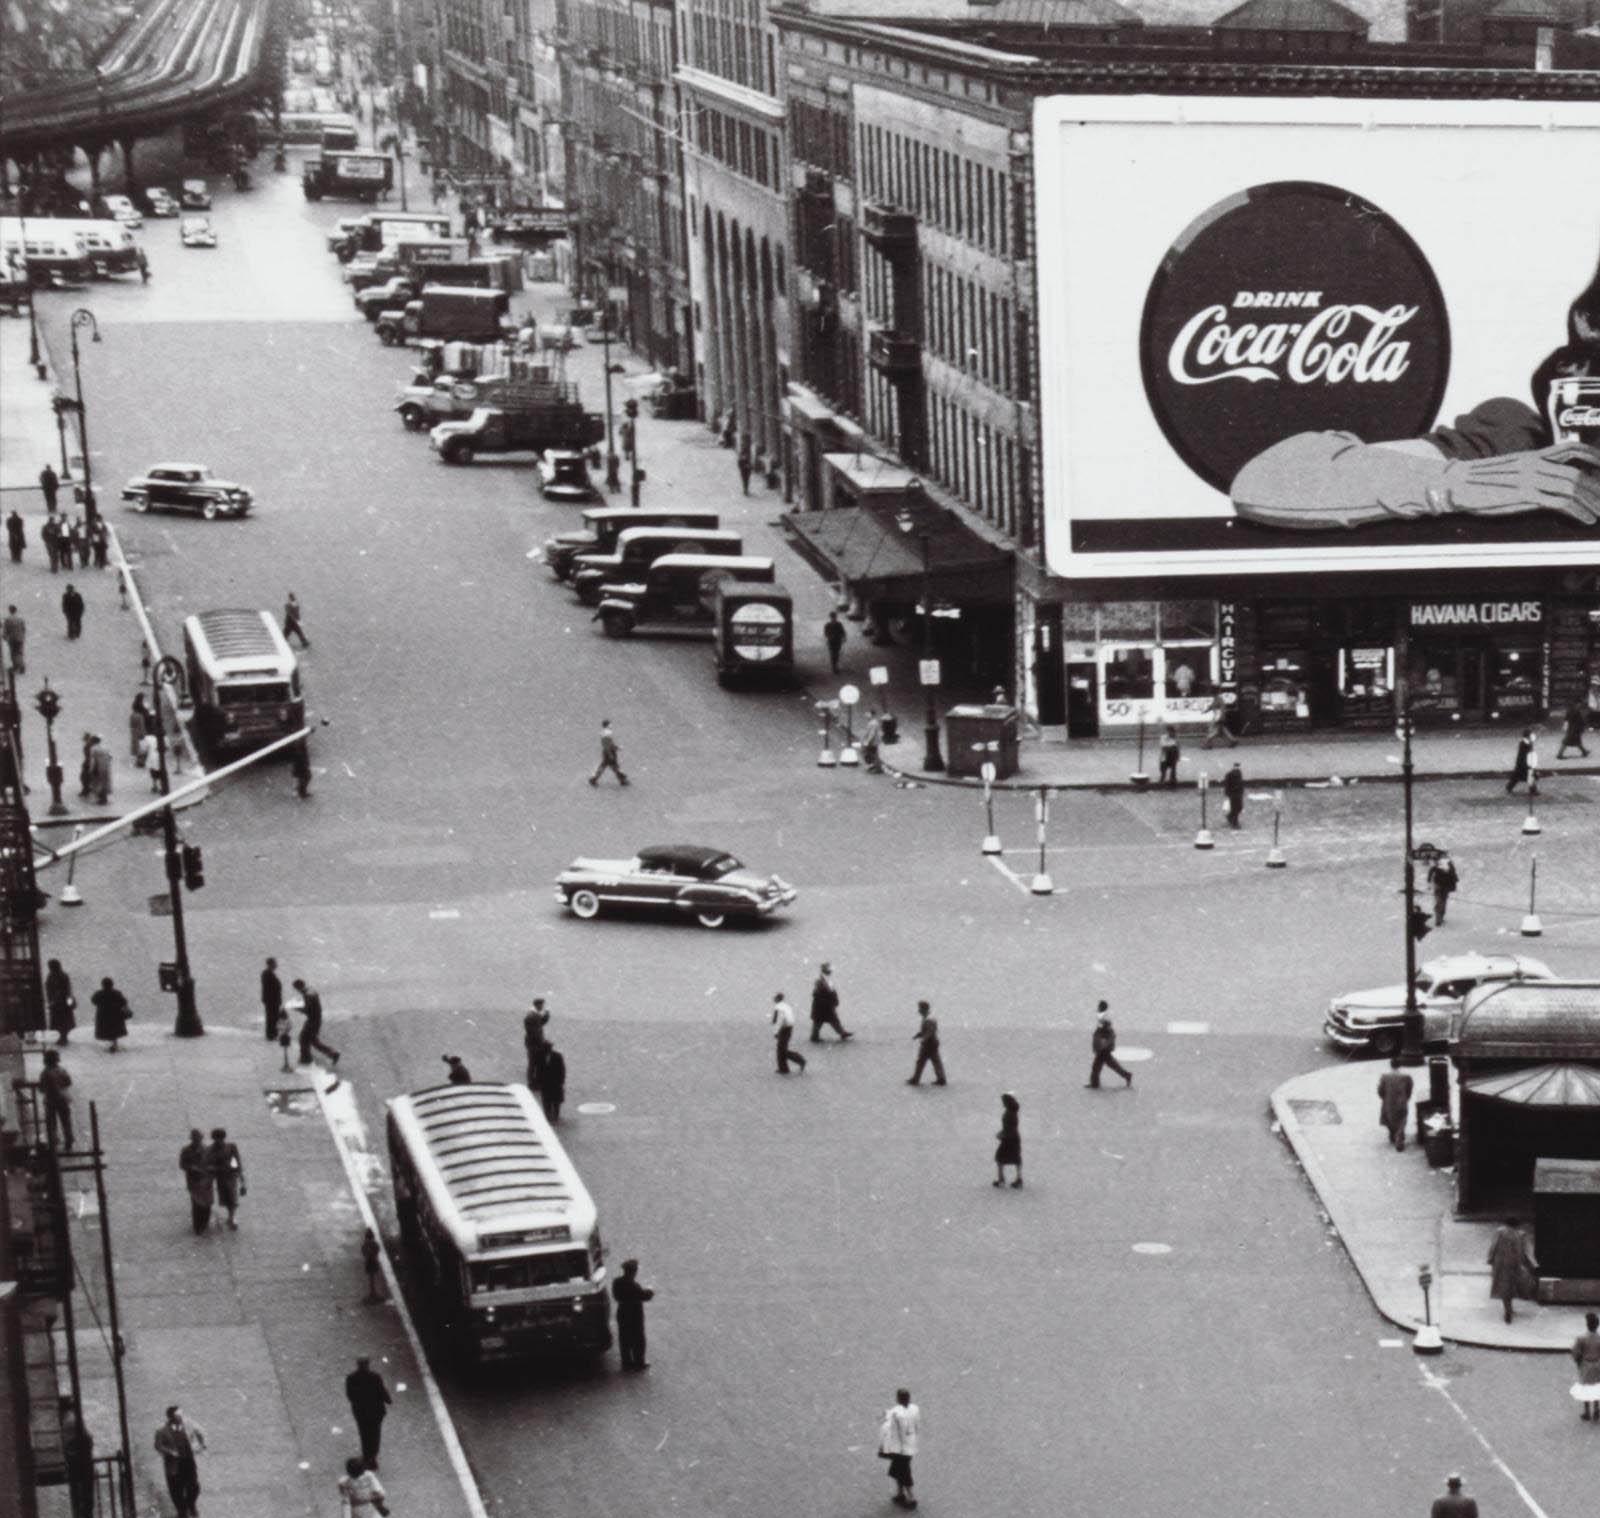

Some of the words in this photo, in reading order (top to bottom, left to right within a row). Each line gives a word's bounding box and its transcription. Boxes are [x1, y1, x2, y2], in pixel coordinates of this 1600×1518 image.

[1233, 291, 1324, 308] DRINK
[1168, 304, 1420, 385] Coca-Cola
[1411, 604, 1478, 625] HAVANA
[1480, 601, 1542, 624] CIGARS
[1220, 603, 1236, 682] HAIRCUT
